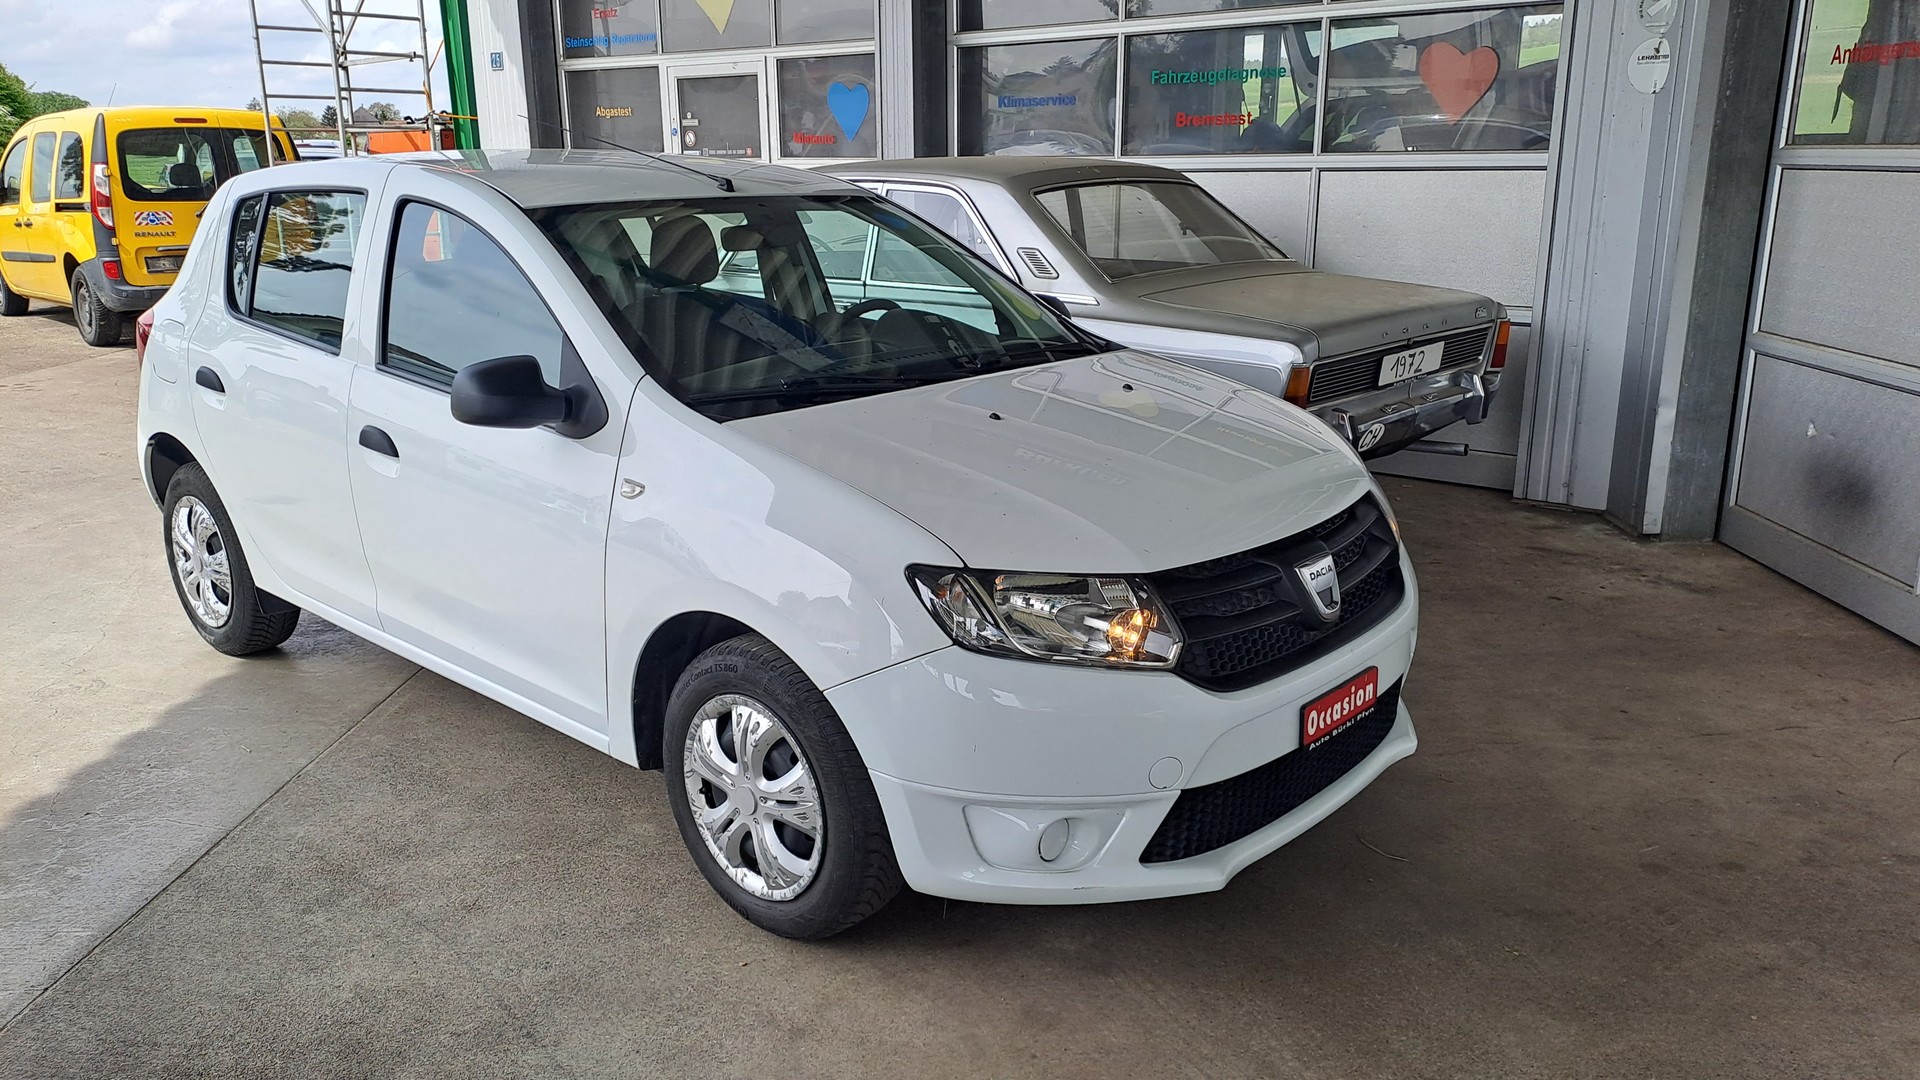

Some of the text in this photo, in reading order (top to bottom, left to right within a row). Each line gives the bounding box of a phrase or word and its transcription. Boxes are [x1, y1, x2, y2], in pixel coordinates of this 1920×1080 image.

[565, 36, 609, 48] Steinschlag
[1151, 65, 1287, 86] Fahrzeugdiagnose
[998, 94, 1077, 108] Klimaservice
[595, 106, 632, 118] Abgastest
[1175, 112, 1253, 127] Bremstest
[1390, 350, 1426, 379] 1972
[1360, 425, 1383, 448] CH
[1309, 564, 1333, 581] DACIA
[1307, 682, 1374, 735] Occasion
[1309, 707, 1375, 751] Auto Bürki Pfyn
